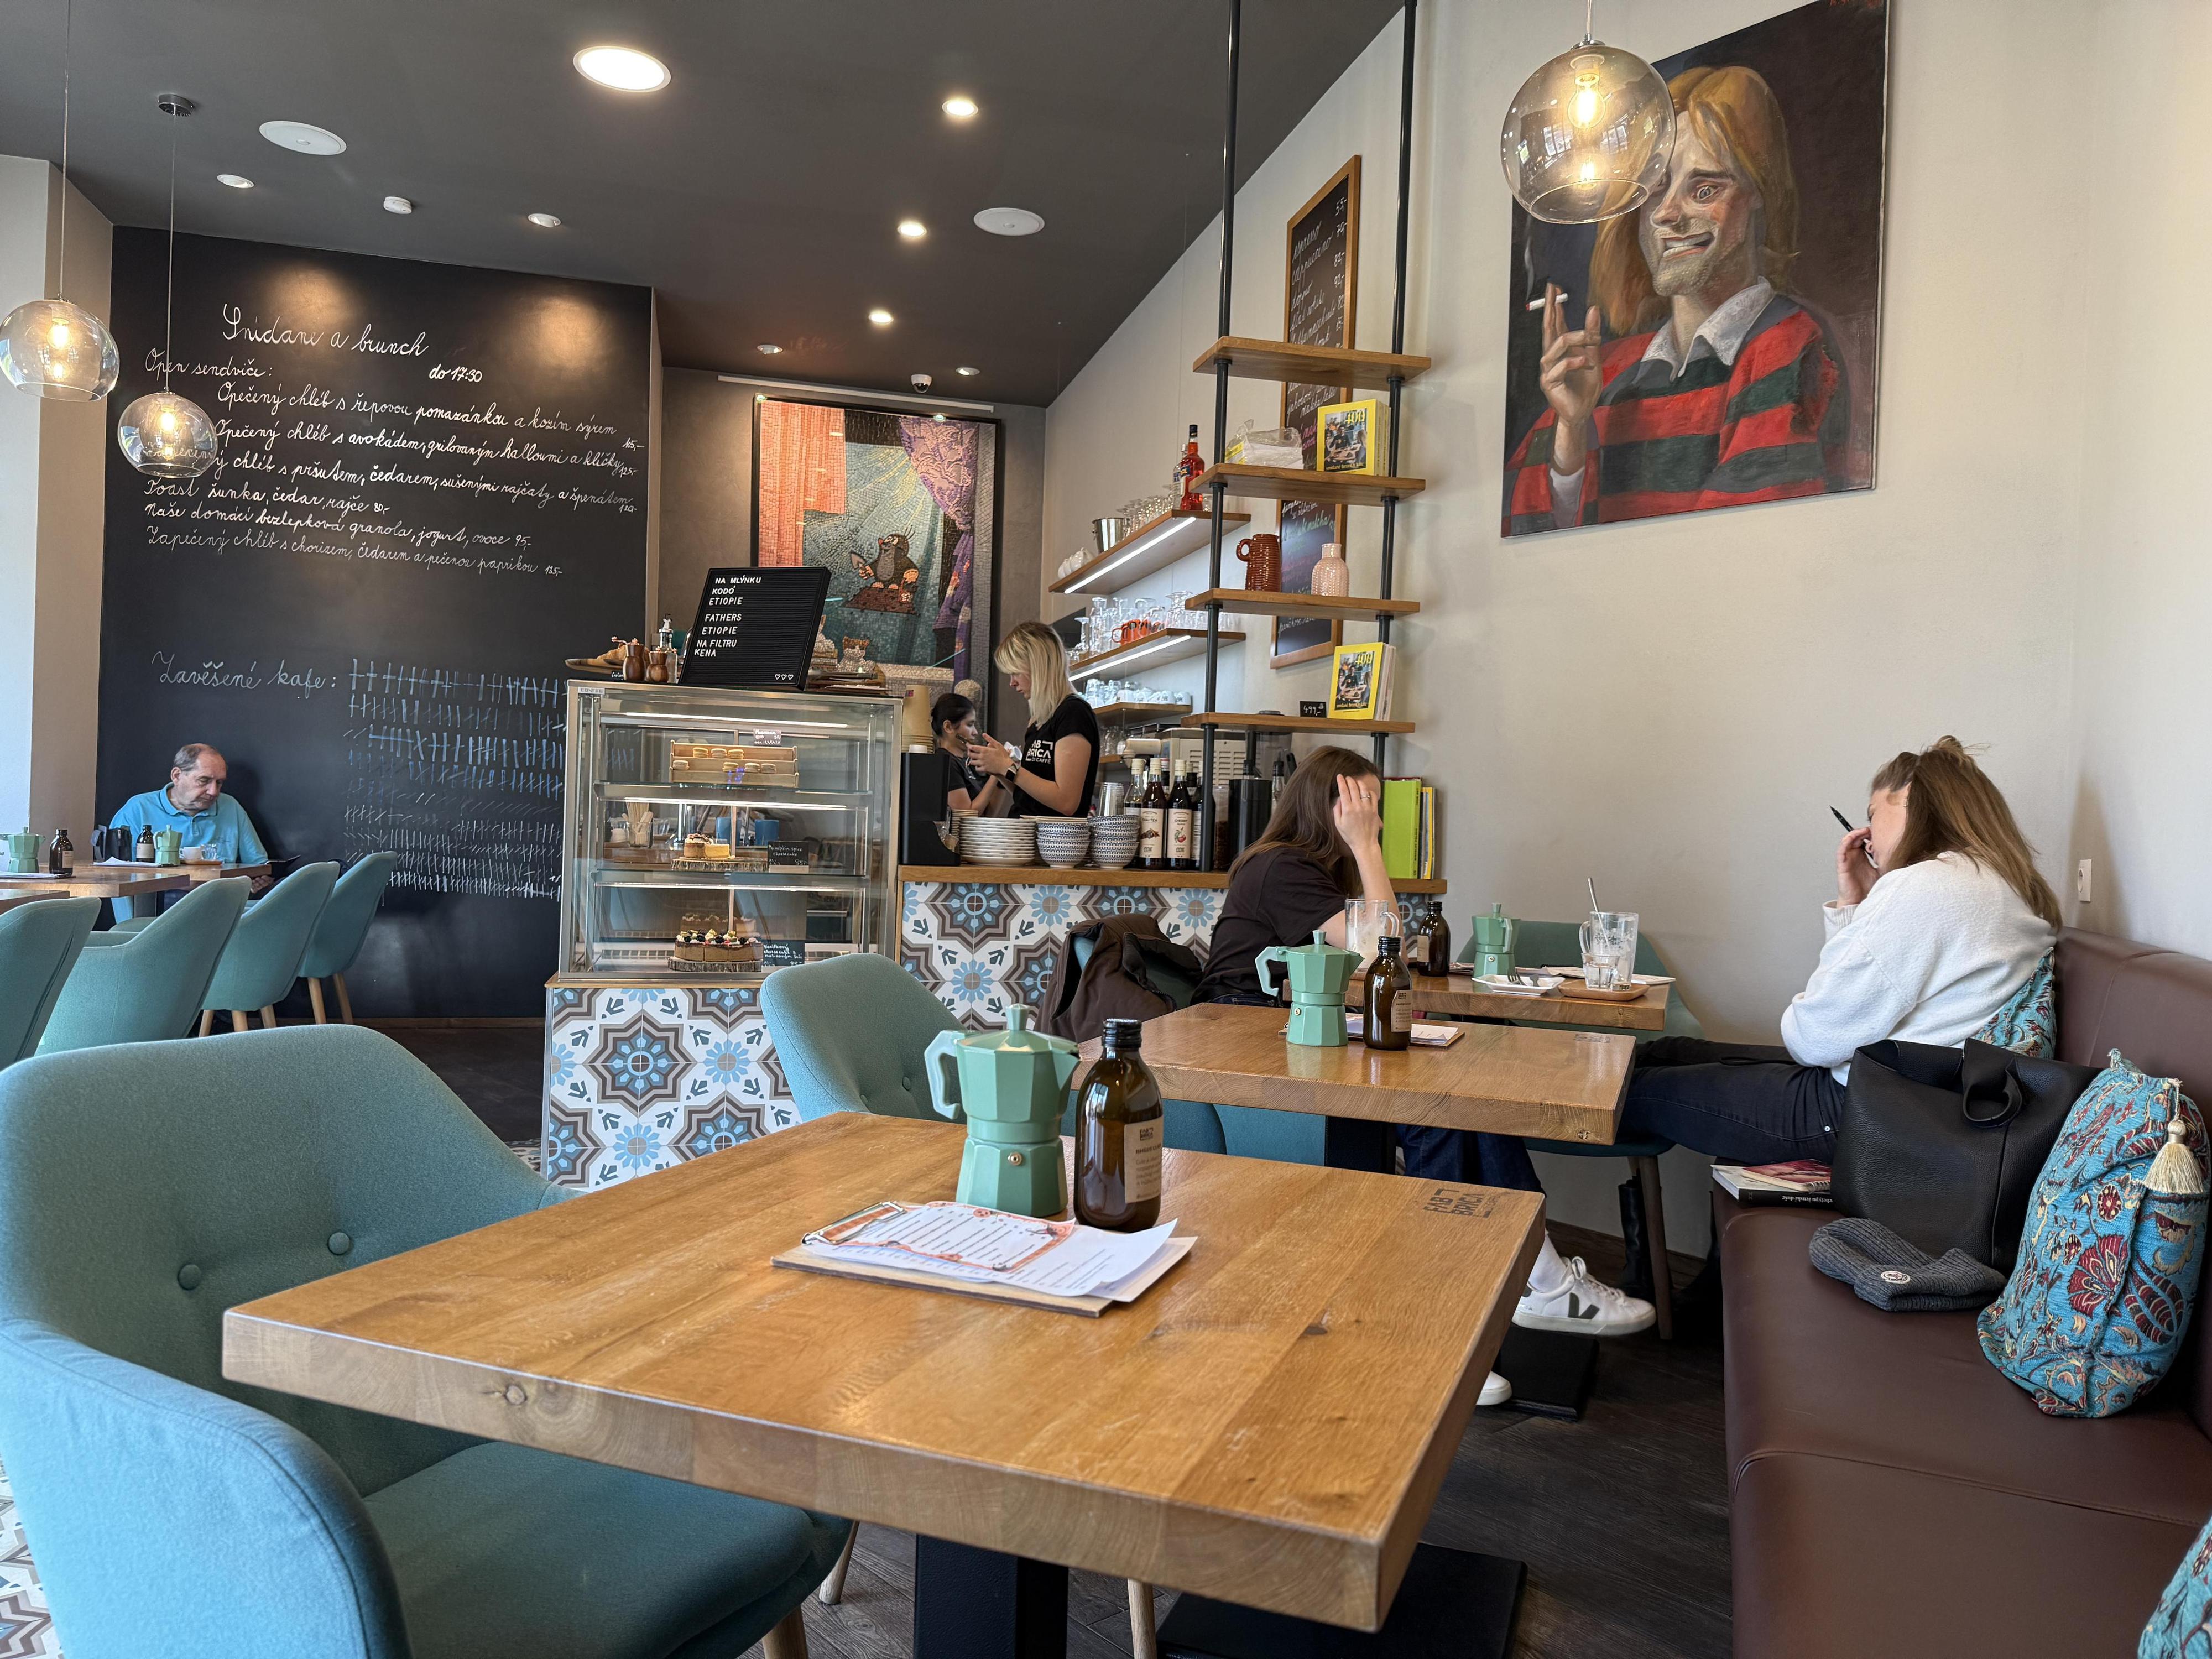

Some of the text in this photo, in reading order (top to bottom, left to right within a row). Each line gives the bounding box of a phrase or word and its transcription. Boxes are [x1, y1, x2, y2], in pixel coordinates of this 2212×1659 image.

[331, 332, 350, 349] a
[351, 323, 429, 357] brunch
[145, 348, 273, 380] Open sendviče:
[429, 364, 482, 383] do 17:30
[218, 381, 287, 415] Opečený
[289, 384, 336, 409] chléb
[335, 395, 347, 411] s
[350, 393, 413, 422] řepovou
[414, 401, 508, 425] pomazánkou
[514, 416, 526, 427] a
[528, 408, 572, 431] kozím
[575, 414, 618, 440] sýrem
[215, 419, 281, 451] Opečený
[286, 421, 331, 442] chléb
[332, 432, 345, 444] s
[348, 427, 426, 453] avokádem,
[426, 435, 500, 465] grilovaným
[500, 438, 570, 465] halloumi
[570, 453, 583, 464] a
[582, 450, 625, 476] klíčky
[232, 450, 275, 474] chléb
[278, 463, 288, 476] s
[290, 459, 366, 486] pršutem,
[369, 463, 438, 491] čedarem,
[440, 471, 500, 497] sušenými
[500, 482, 555, 509] rajčaty
[557, 489, 571, 500] a
[569, 487, 633, 510] špenátem
[144, 477, 200, 497] Toast
[208, 481, 269, 505] šunka,
[273, 486, 326, 510] čedar,
[326, 495, 370, 519] rajče
[144, 502, 187, 519] Naše
[190, 500, 254, 523] domácí
[255, 508, 345, 534] bezlepková
[349, 520, 415, 542] granola,
[416, 525, 469, 549] jogurt,
[472, 534, 512, 545] ovoce
[147, 525, 230, 556] Zapečený
[233, 528, 279, 549] chléb
[279, 540, 288, 550] s
[291, 535, 353, 561] chorizem,
[357, 541, 411, 562] čedarem
[414, 553, 426, 563] a
[424, 552, 477, 570] pečenou
[476, 554, 539, 575] paprikou
[712, 585, 735, 595] KODÓ
[730, 575, 761, 584] MLÝNKU
[705, 613, 742, 622] FATHERS
[708, 597, 743, 606] ETIOPIE
[696, 639, 737, 648] NA FILTRU
[701, 626, 738, 635] ETIOPIE
[694, 649, 716, 657] KENA
[152, 651, 336, 699] Zavěšené kafe:
